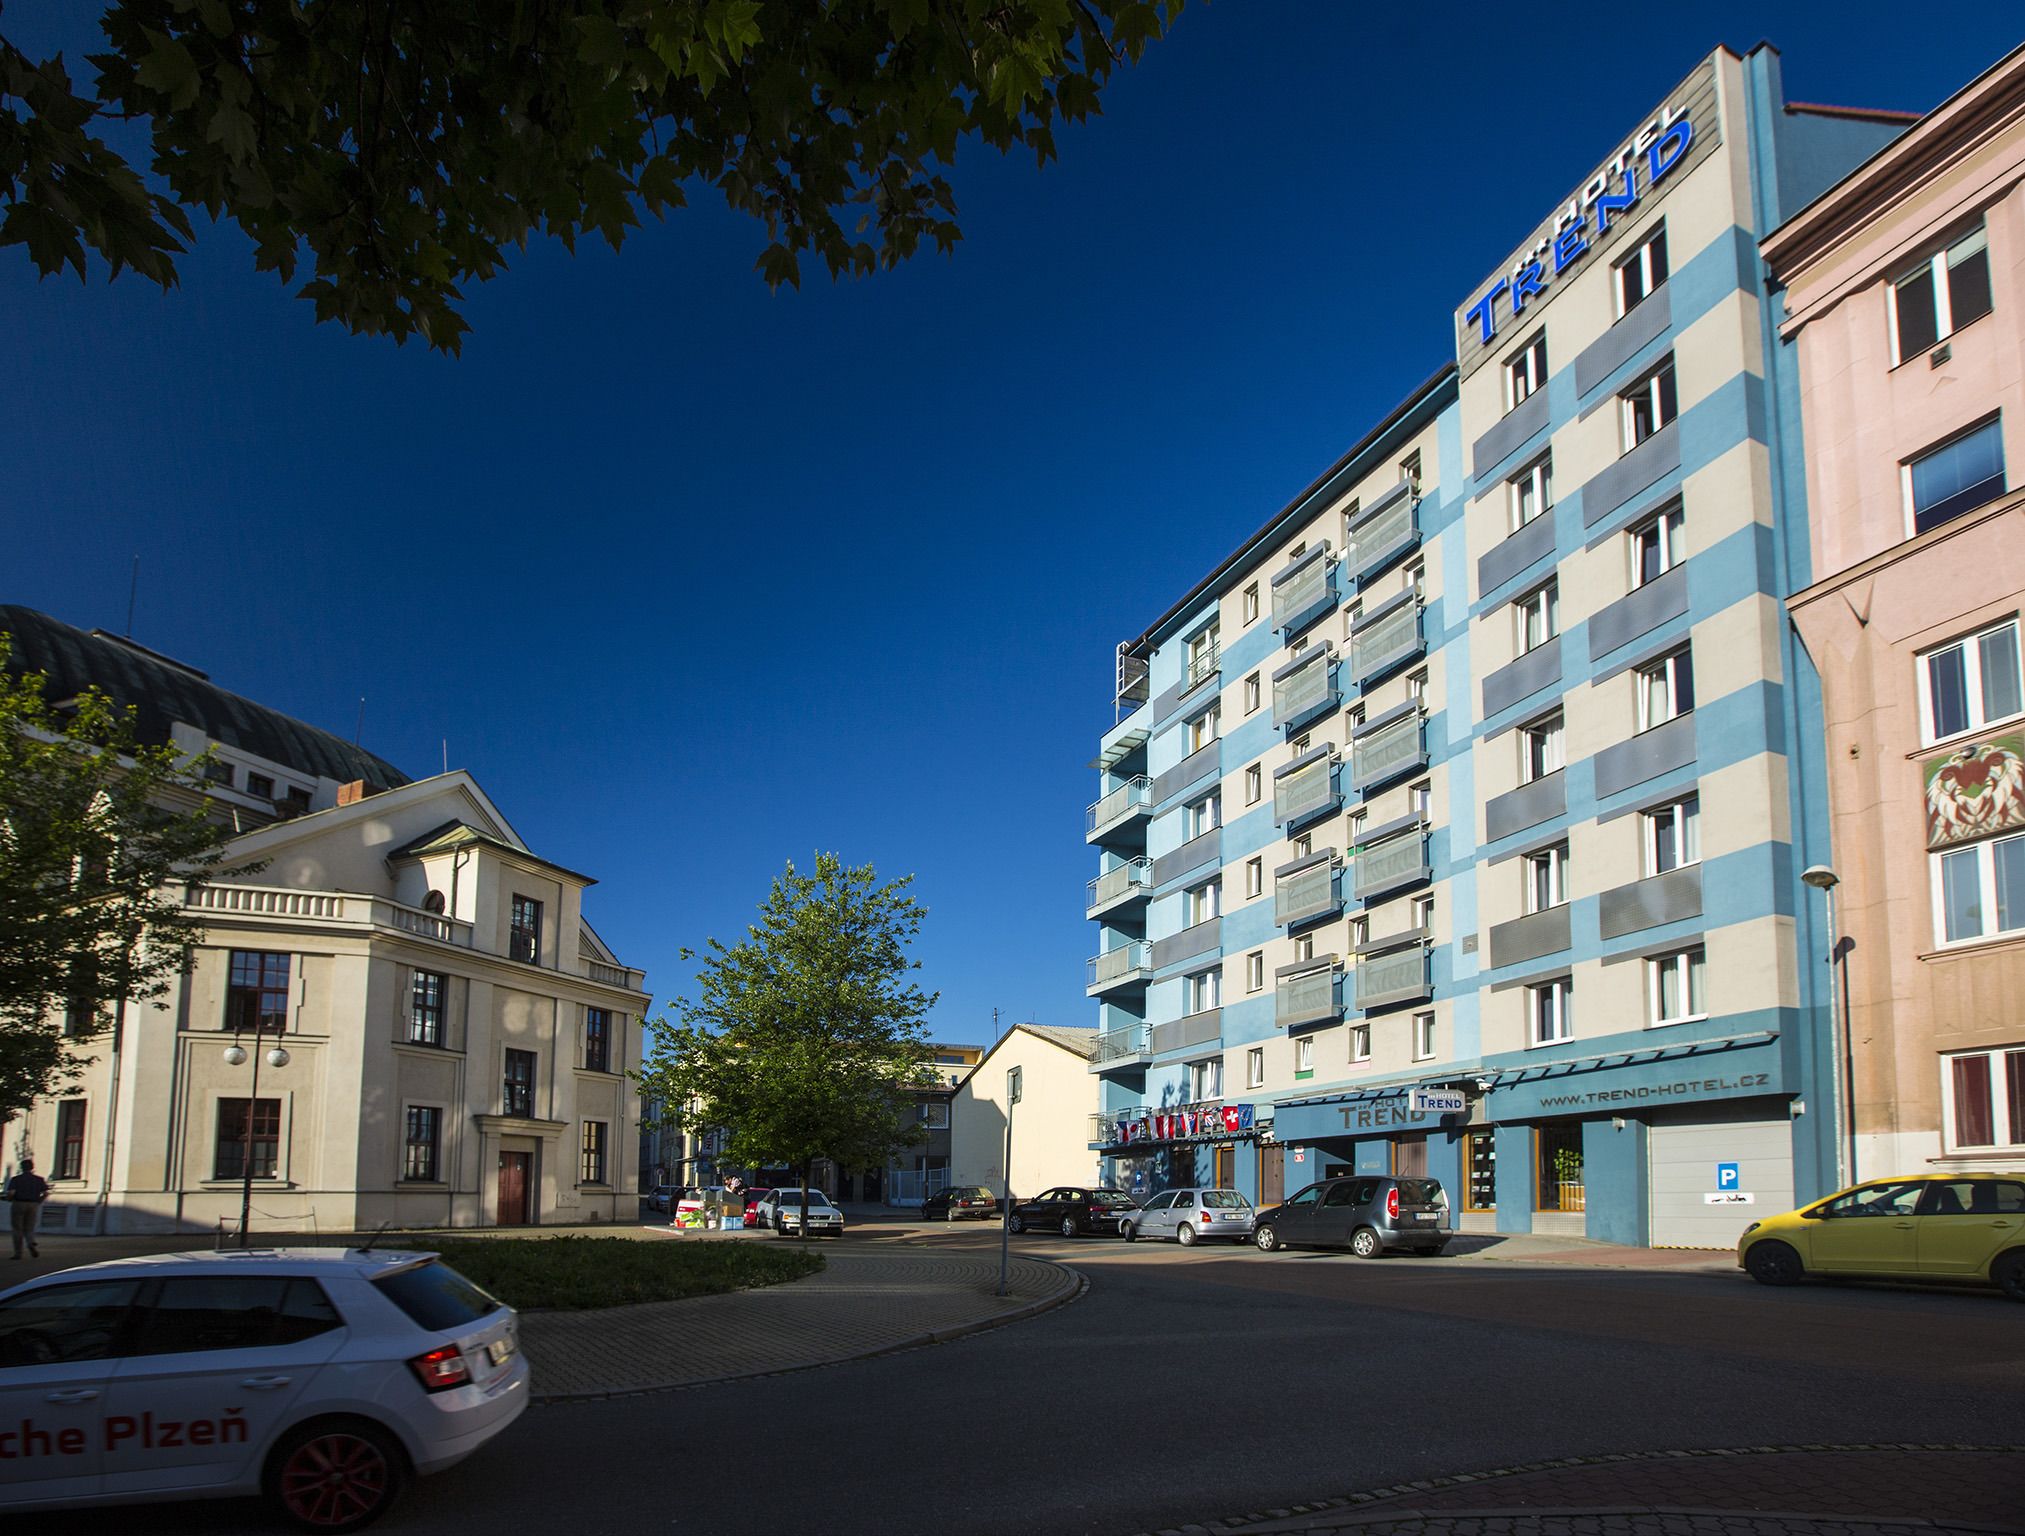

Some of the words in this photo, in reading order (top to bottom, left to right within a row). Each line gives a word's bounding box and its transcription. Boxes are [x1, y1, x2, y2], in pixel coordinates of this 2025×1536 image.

[1554, 104, 1688, 237] HOTEL
[1465, 120, 1694, 345] TREND
[1417, 1094, 1462, 1109] TREND
[1540, 1073, 1770, 1108] WWW.TREND-HOTEL.CZ
[1338, 1104, 1426, 1129] TREND
[1136, 1174, 1142, 1182] P
[1721, 1168, 1737, 1186] P
[106, 1407, 248, 1451] Plzeň
